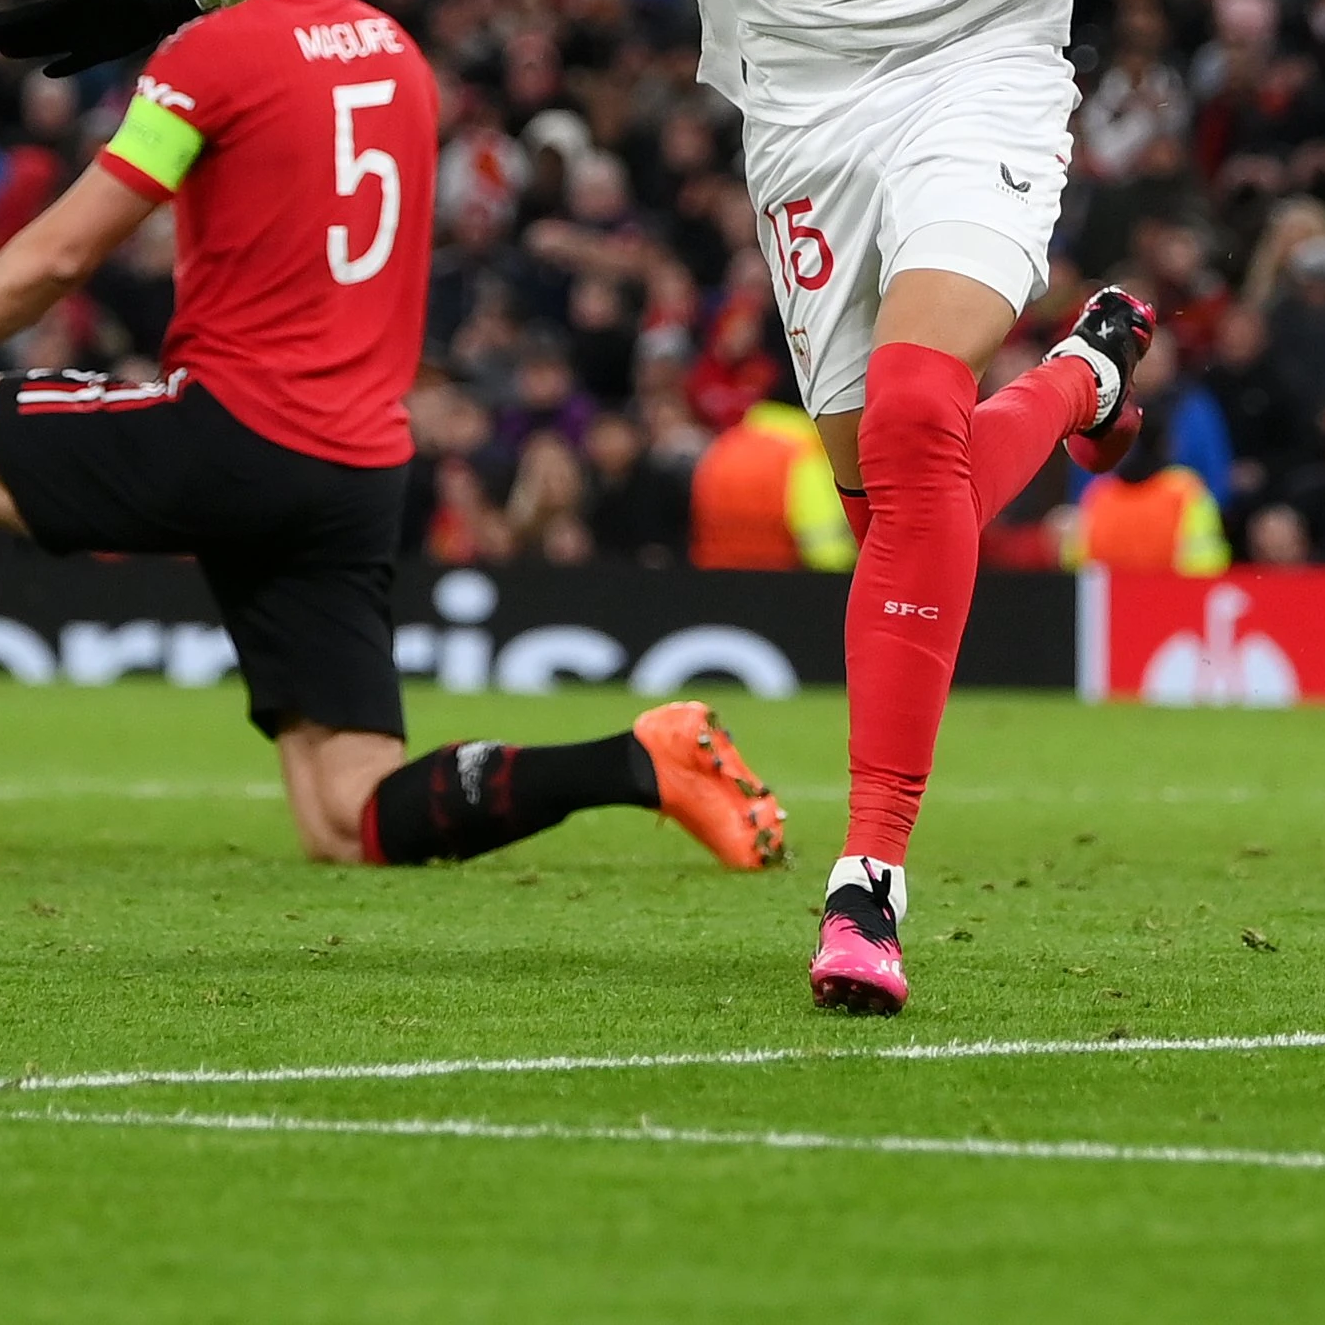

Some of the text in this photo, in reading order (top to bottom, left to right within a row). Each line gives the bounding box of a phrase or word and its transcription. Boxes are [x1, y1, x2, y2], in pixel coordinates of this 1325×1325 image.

[326, 78, 402, 286] 5
[763, 195, 835, 299] 15
[883, 600, 940, 621] SFC
